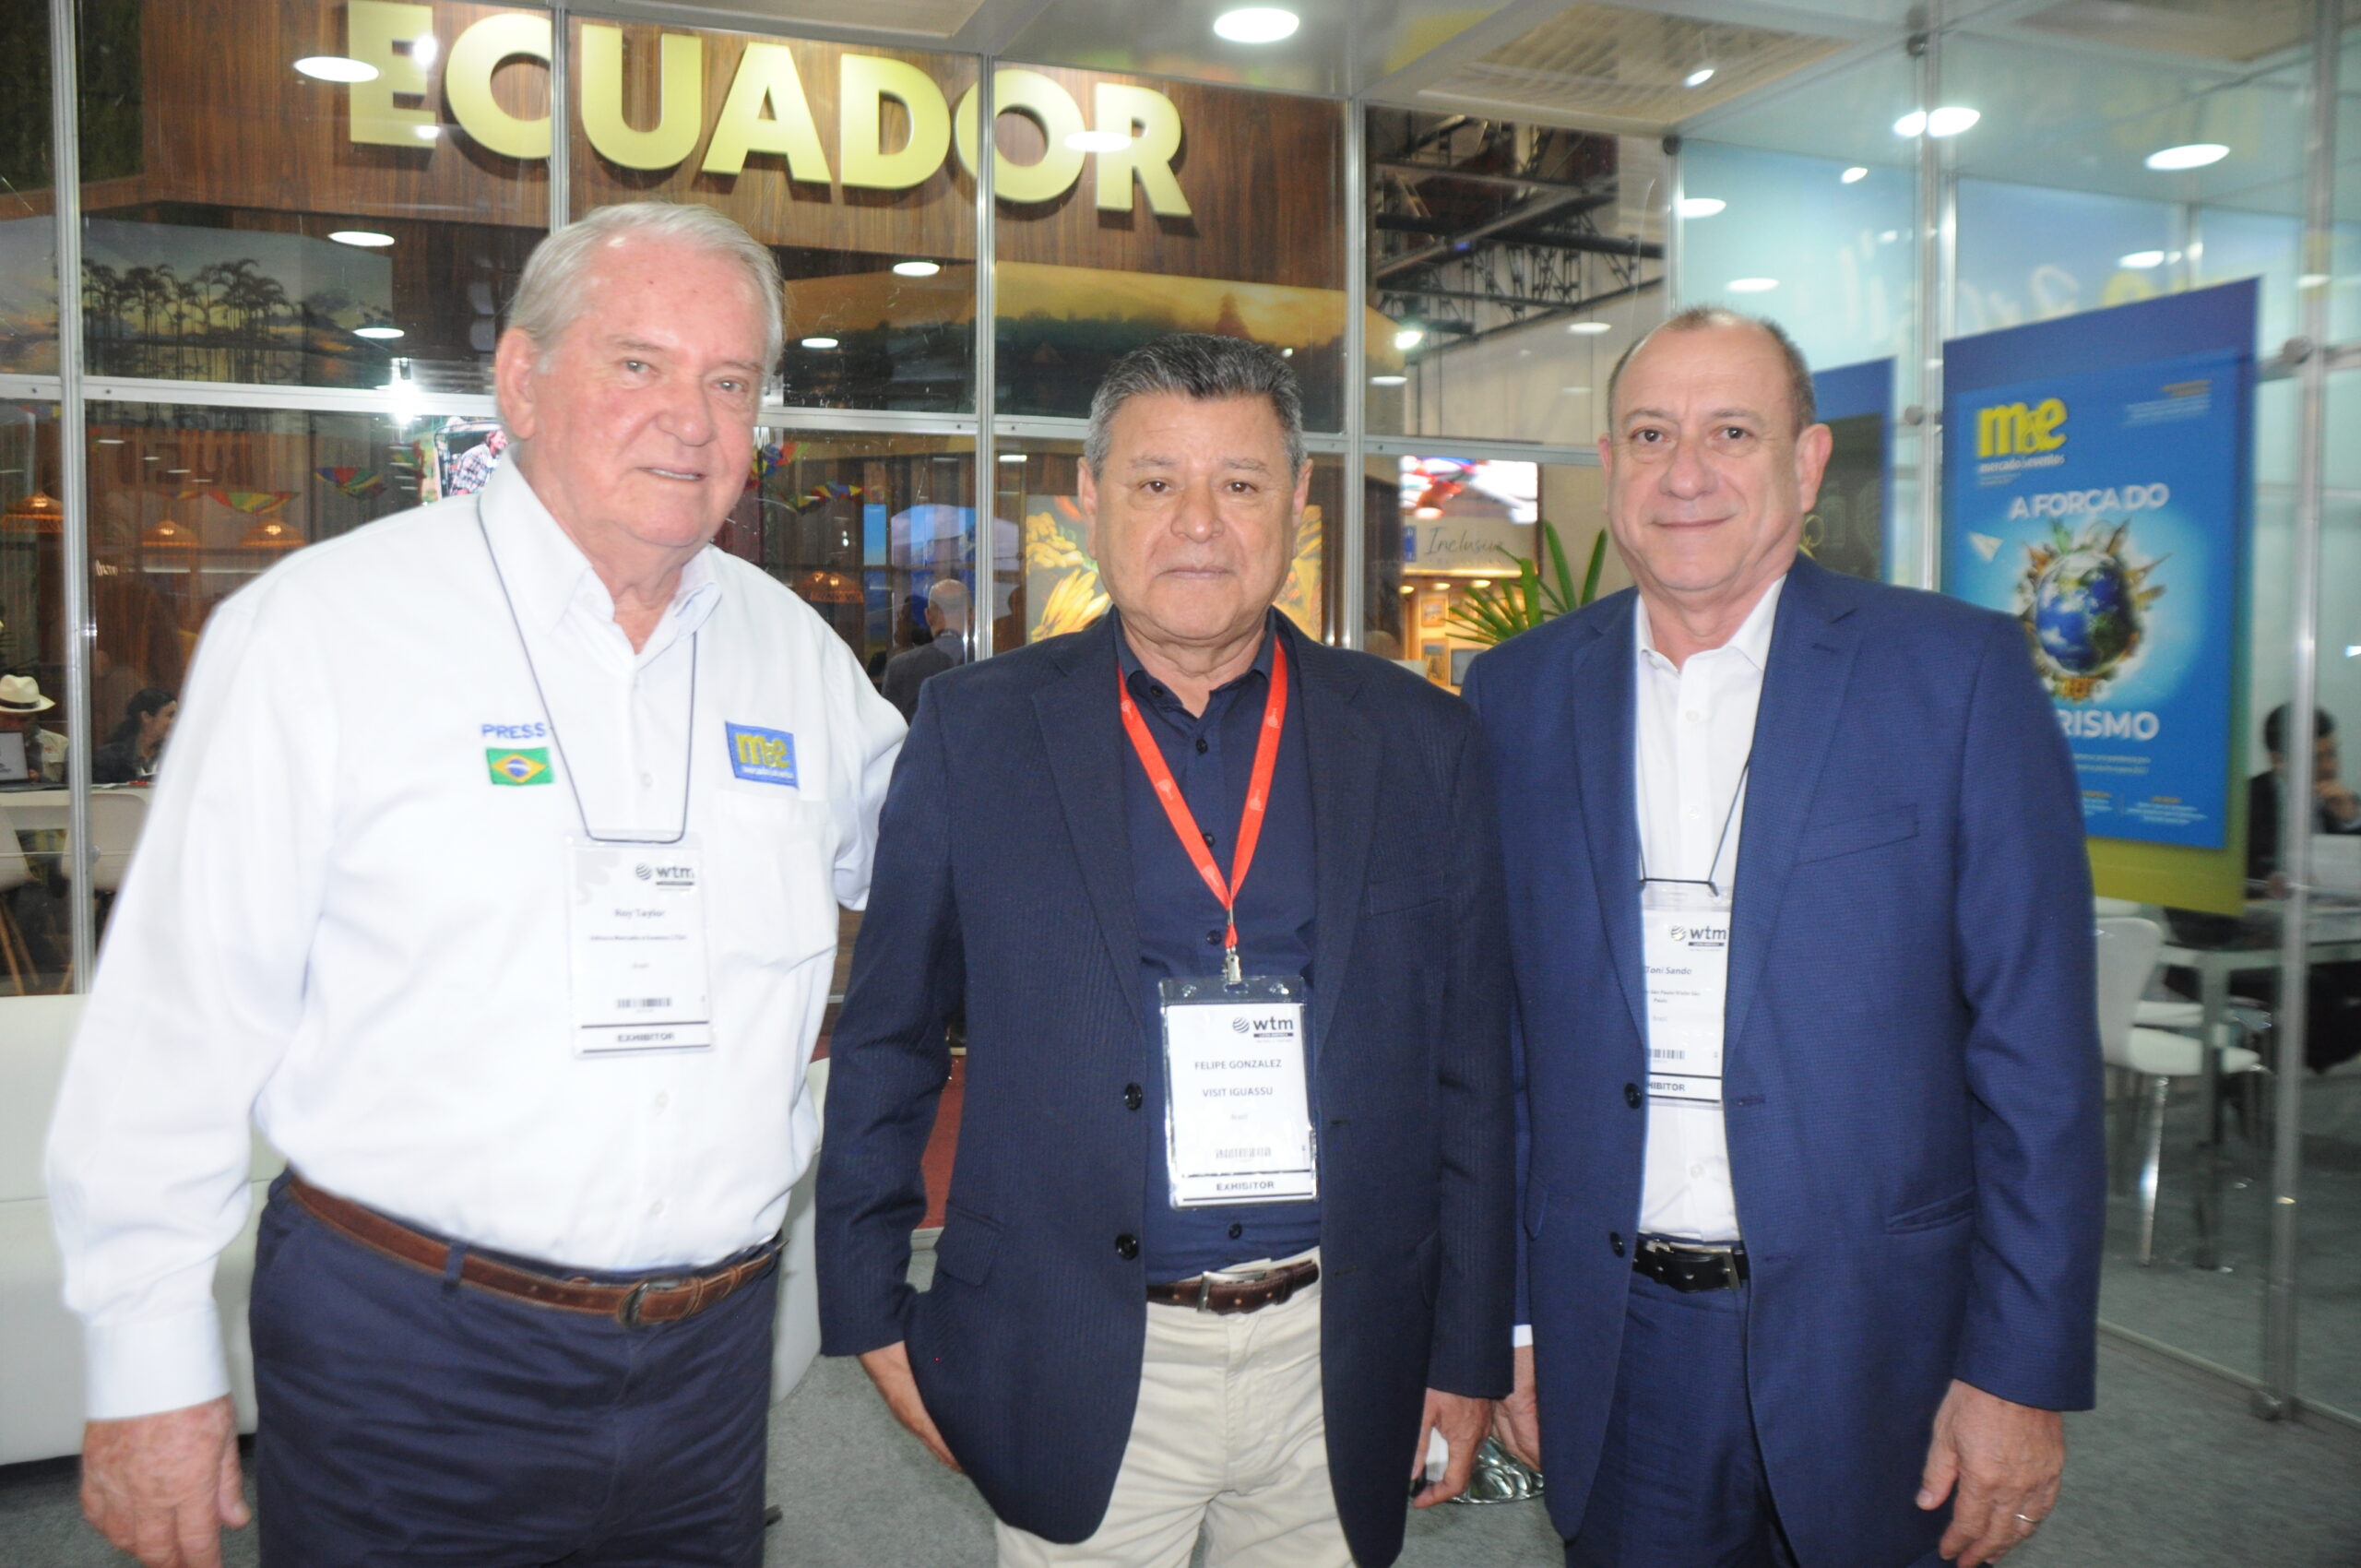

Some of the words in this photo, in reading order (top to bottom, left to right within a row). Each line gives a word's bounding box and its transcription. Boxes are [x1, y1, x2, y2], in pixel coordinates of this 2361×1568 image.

[348, 0, 1192, 218] ECUADOR
[2008, 496, 2030, 520] A
[2032, 487, 2121, 518] FORÇA
[2124, 481, 2170, 510] DO
[481, 722, 546, 740] PRESS
[2057, 708, 2160, 742] RISMO
[656, 864, 694, 879] wtm
[1690, 925, 1726, 940] wtm
[1666, 967, 1692, 976] Sando
[1252, 1016, 1294, 1031] wtm
[1194, 1060, 1227, 1071] FELIPE
[1228, 1059, 1282, 1070] GONZALEZ
[1202, 1088, 1227, 1098] VISIT
[1228, 1087, 1274, 1097] IGUASSU
[1649, 1081, 1686, 1092] HIBITOR
[1216, 1181, 1275, 1192] EXHIBITOR
